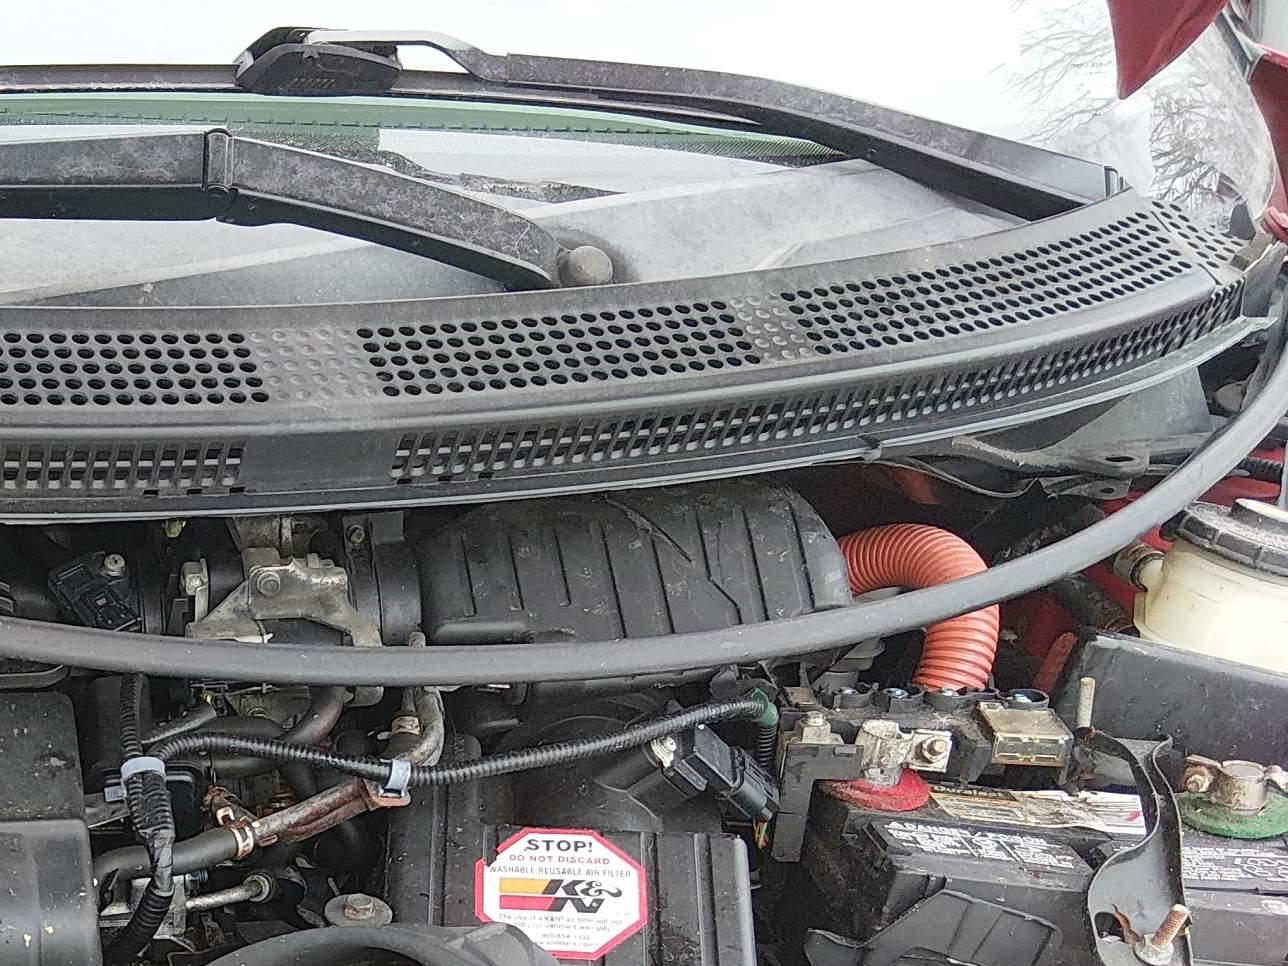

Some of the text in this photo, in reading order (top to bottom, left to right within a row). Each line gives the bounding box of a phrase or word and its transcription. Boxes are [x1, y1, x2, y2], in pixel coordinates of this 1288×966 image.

[526, 839, 593, 852] STOP!
[509, 854, 610, 865] DO NOT DISCARD
[489, 866, 631, 878] WASHABLE REUSABLE AIR FILTER
